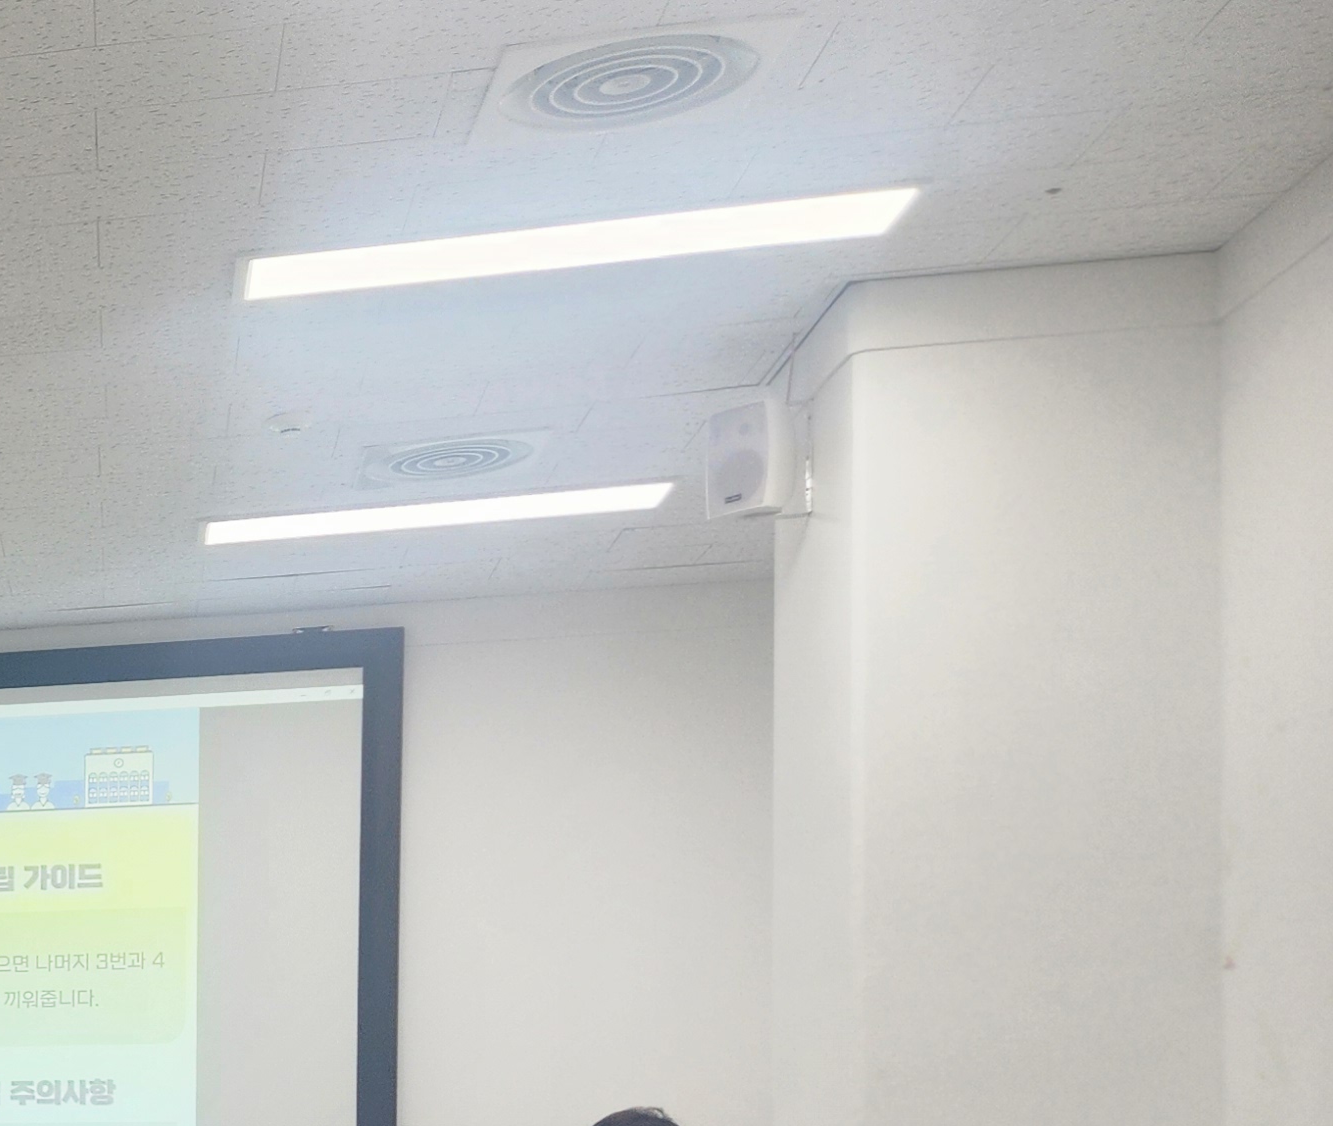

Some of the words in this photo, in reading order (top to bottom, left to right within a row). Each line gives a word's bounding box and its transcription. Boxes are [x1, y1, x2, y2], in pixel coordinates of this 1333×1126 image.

[23, 863, 104, 891] 가이드
[35, 952, 90, 972] 나머지
[95, 951, 146, 971] 3번과
[152, 951, 166, 969] 4
[3, 988, 100, 1009] 끼워줍니다.
[9, 1078, 117, 1107] 주의사항
